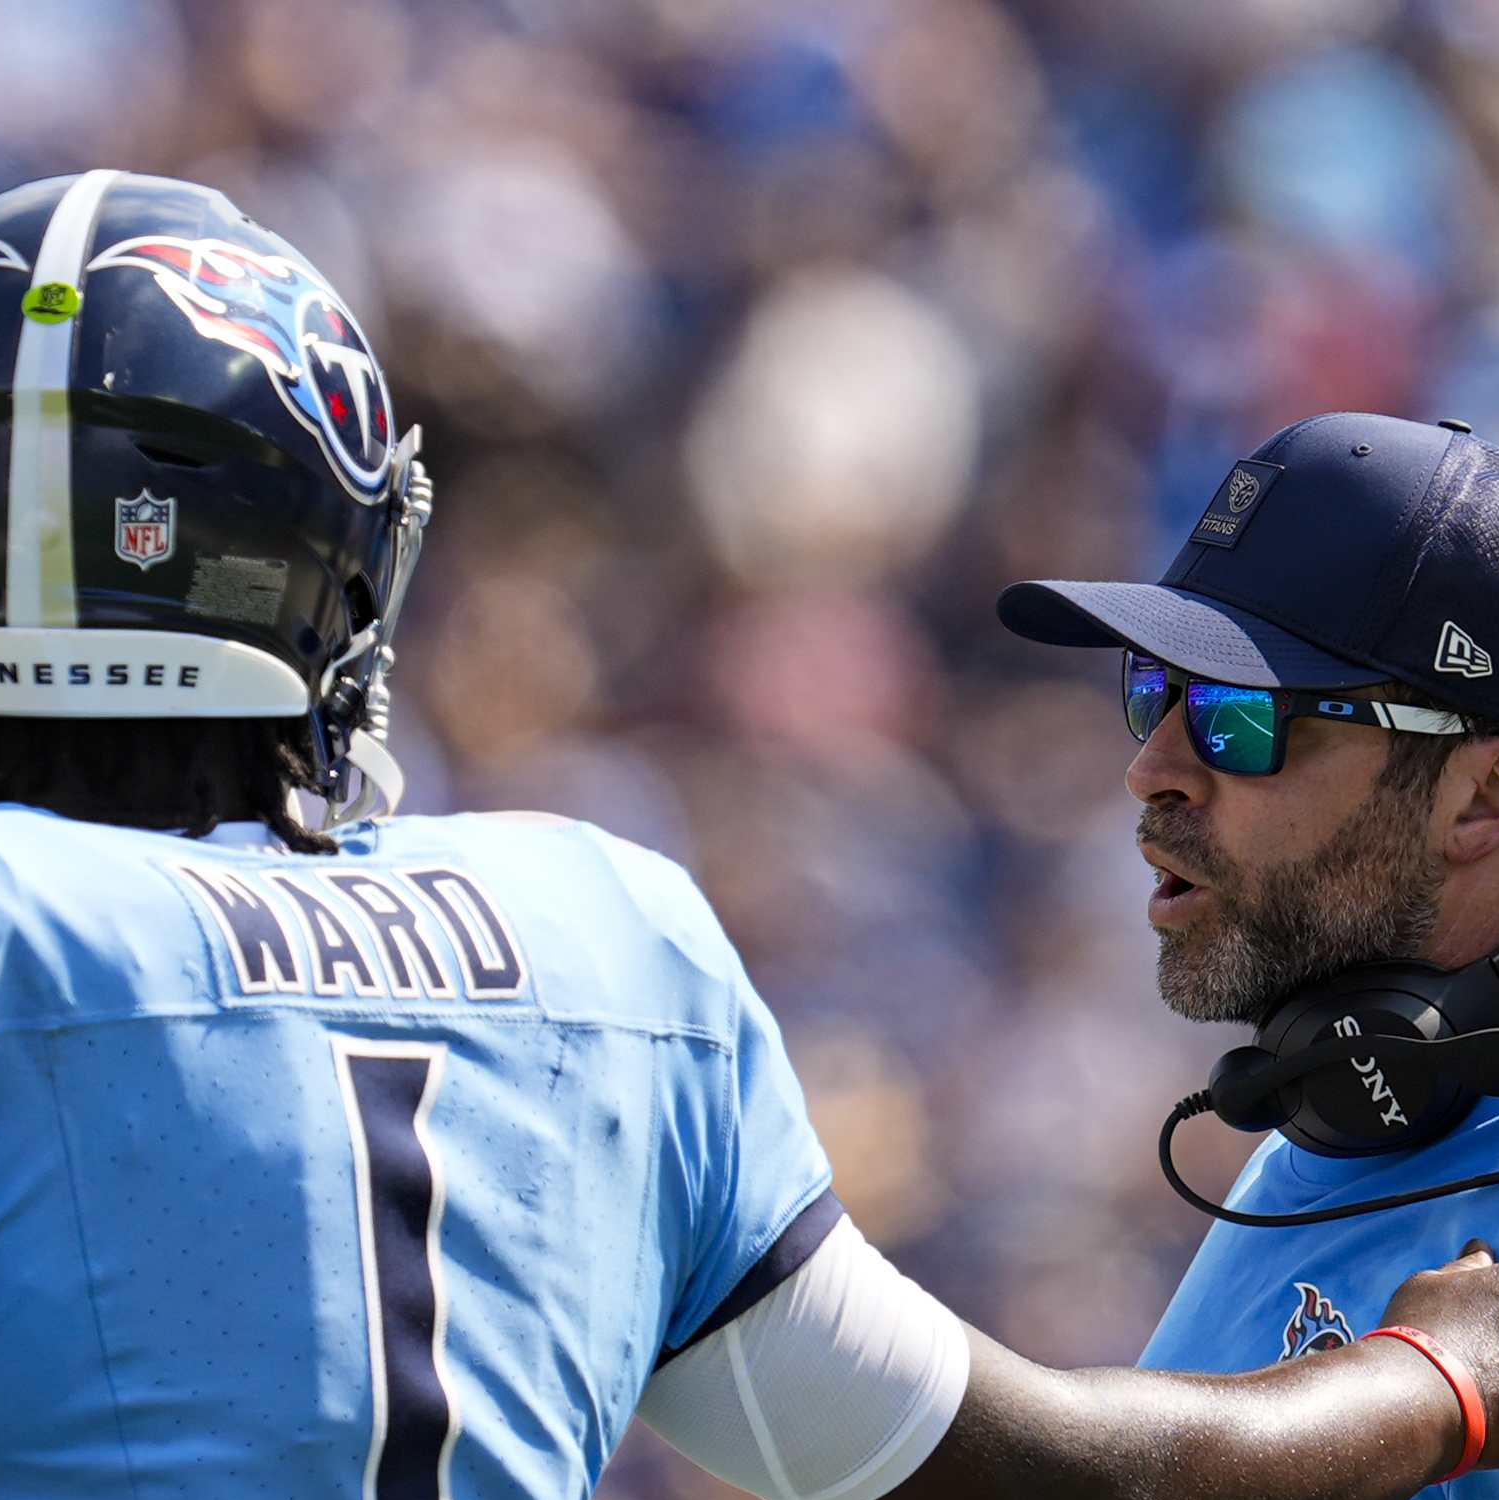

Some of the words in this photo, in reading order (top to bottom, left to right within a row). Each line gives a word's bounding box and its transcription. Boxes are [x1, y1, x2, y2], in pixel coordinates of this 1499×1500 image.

[122, 524, 164, 555] NFL
[1200, 518, 1237, 535] TITANS
[167, 863, 528, 1000] WARD
